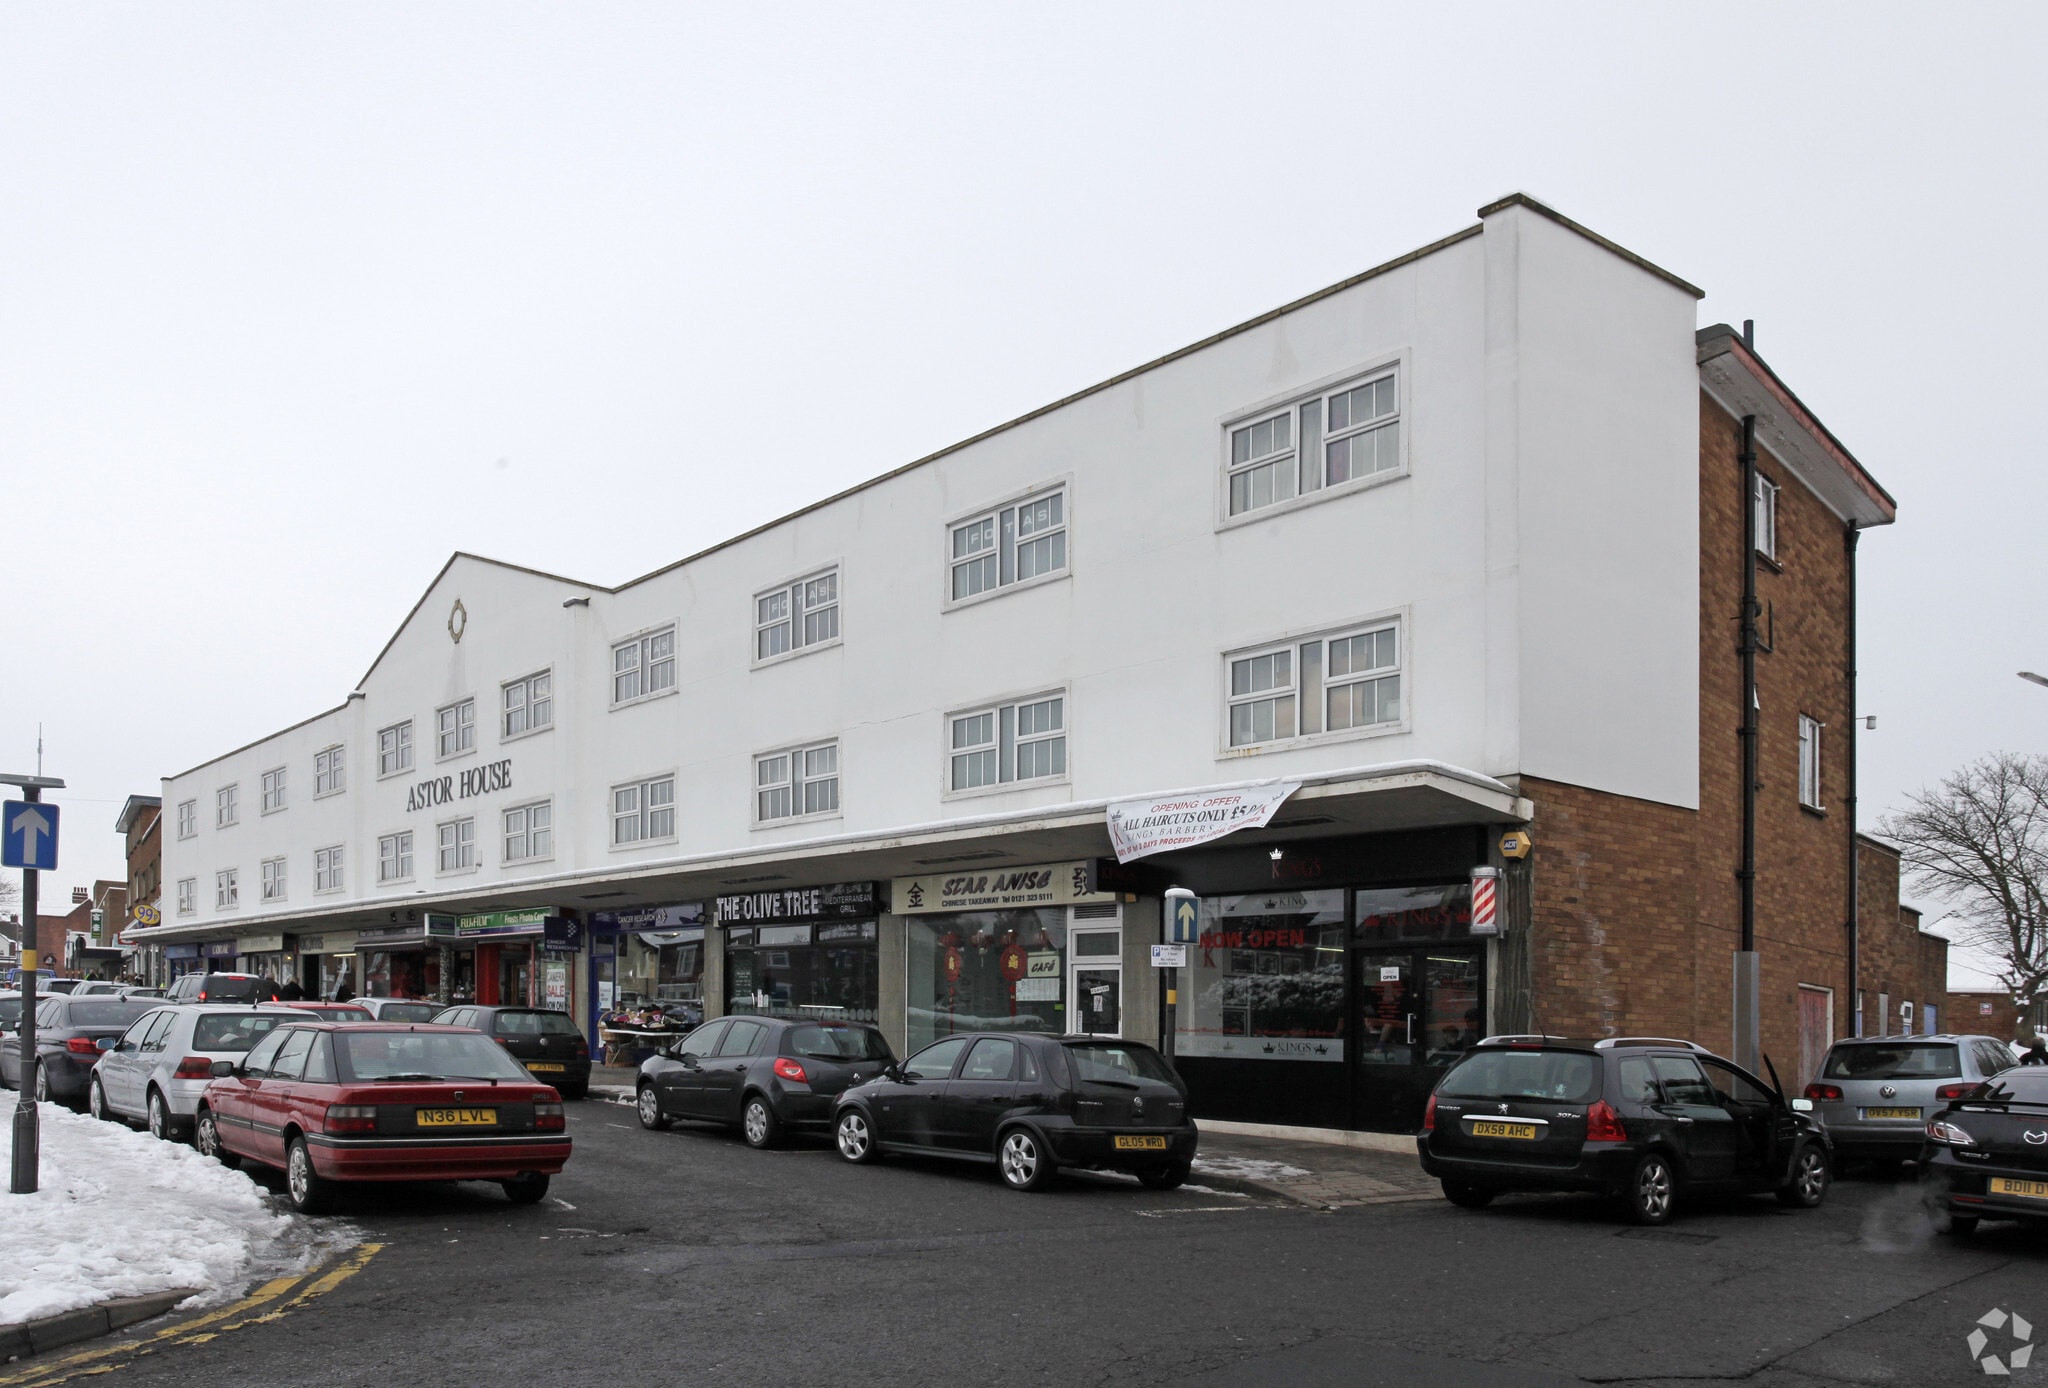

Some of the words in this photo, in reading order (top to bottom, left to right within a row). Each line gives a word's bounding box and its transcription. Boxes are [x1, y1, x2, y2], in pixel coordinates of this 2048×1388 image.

[406, 776, 454, 812] ASTOR
[459, 759, 511, 799] HOUSE
[1150, 799, 1199, 813] OPENING
[1202, 796, 1242, 809] OFFER
[1122, 819, 1141, 832] ALL
[1142, 811, 1197, 828] HAIRCUTS
[1197, 808, 1229, 823] ONLY
[1126, 829, 1155, 843] KINGS
[1159, 825, 1215, 836] BARBERS
[1159, 836, 1196, 846] PROCEEDS
[1504, 841, 1516, 849] ADT
[942, 876, 988, 897] STAR
[992, 870, 1052, 893] ANISE
[824, 894, 872, 905] MEDITERRANEAN
[907, 882, 925, 908] 金
[942, 898, 967, 907] CHINESE
[968, 896, 1000, 906] TAKEAWAY
[1002, 895, 1010, 903] Tel
[1011, 894, 1026, 903] 0121
[1026, 893, 1038, 902] 323
[1039, 892, 1053, 900] 5111
[716, 896, 740, 921] THE
[743, 892, 781, 919] OLIVE
[784, 889, 819, 916] TREE
[839, 905, 857, 913] GRILL
[504, 914, 519, 924] Frosts
[519, 913, 533, 923] Photo
[618, 915, 634, 923] CANCER
[634, 913, 655, 922] RESEARCH
[1387, 907, 1451, 928] KINGS
[1200, 930, 1243, 949] NOW
[1248, 928, 1305, 948] OPEN
[1031, 959, 1056, 973] CAFÉ
[547, 971, 565, 982] CAMERA
[546, 985, 565, 997] SALE
[1278, 1042, 1312, 1053] KINGS
[423, 1110, 455, 1123] N36
[459, 1109, 490, 1122] LVL
[1897, 1107, 1918, 1117] YSR
[1477, 1123, 1505, 1136] DX58
[1508, 1124, 1531, 1137] AHC
[2004, 1180, 2032, 1193] BD11
